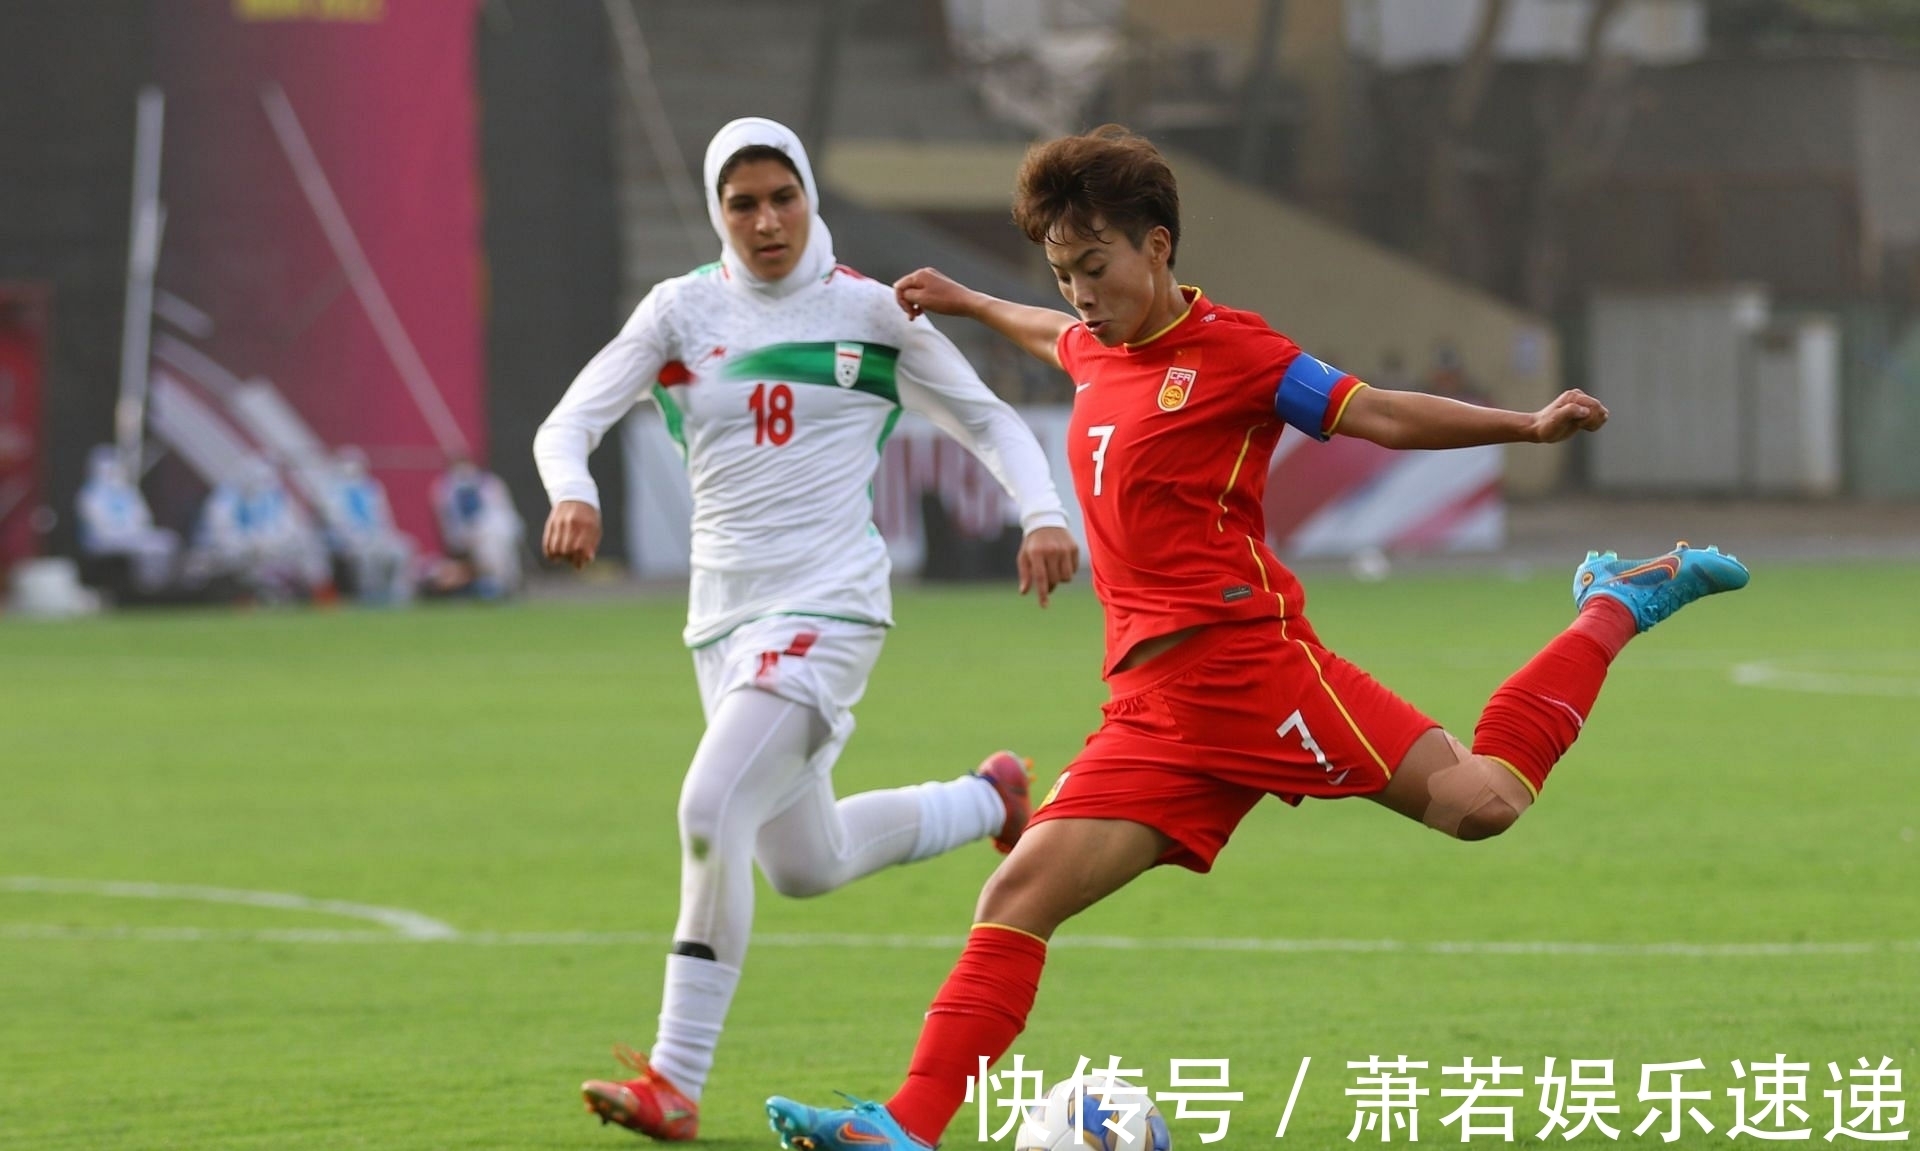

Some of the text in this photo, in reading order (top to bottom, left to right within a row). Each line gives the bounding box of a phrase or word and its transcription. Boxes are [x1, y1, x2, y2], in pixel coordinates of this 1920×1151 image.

[1169, 371, 1192, 382] CFA
[748, 383, 794, 446] 18
[1087, 425, 1115, 496] 7
[1276, 709, 1334, 773] 7
